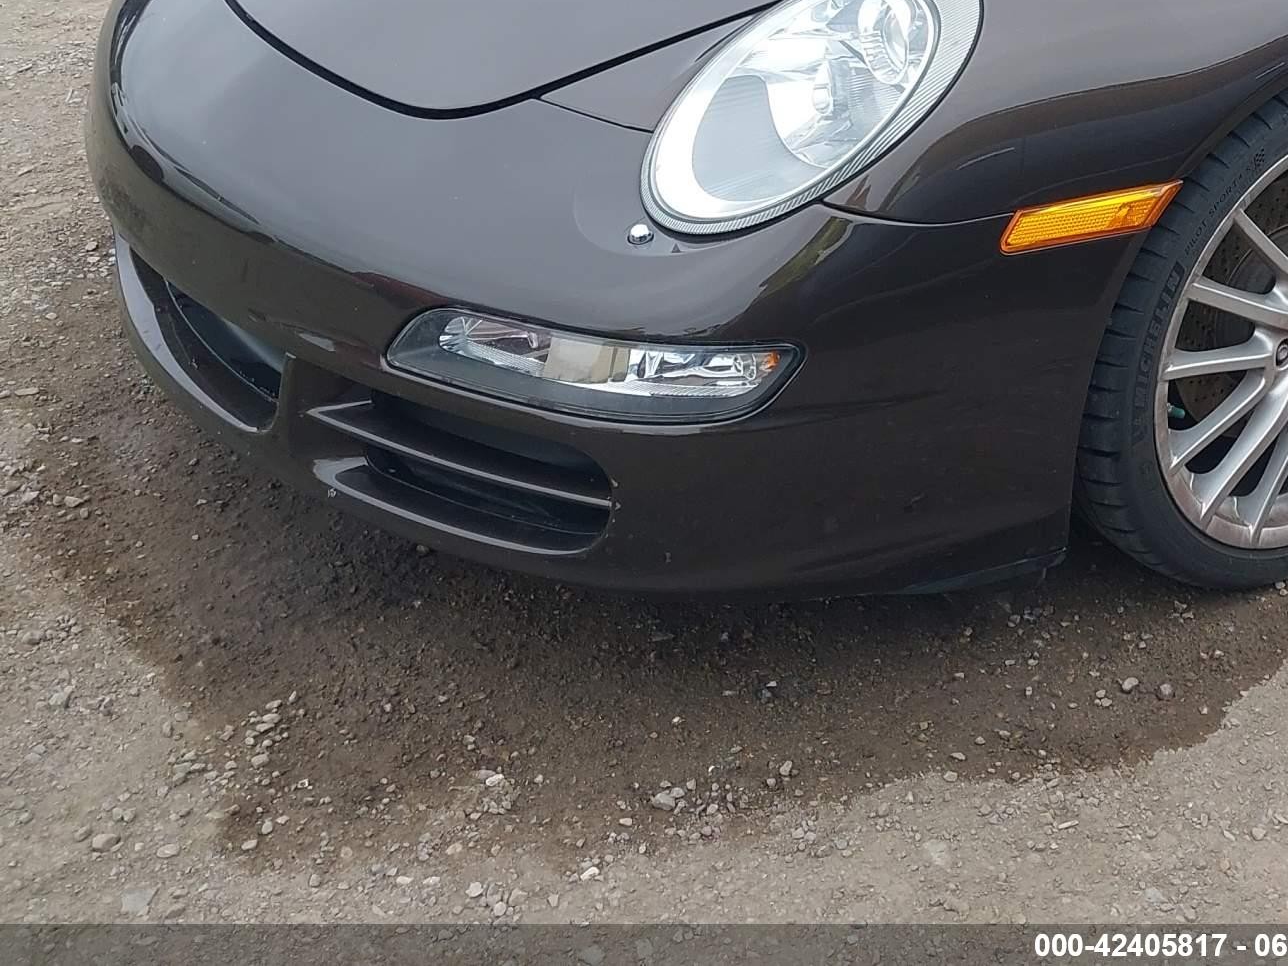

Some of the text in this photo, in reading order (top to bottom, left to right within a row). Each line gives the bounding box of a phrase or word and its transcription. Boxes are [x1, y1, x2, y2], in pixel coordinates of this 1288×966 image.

[1184, 219, 1208, 255] PILOT
[1208, 180, 1238, 216] SPORT
[1134, 271, 1182, 408] MICHELIN
